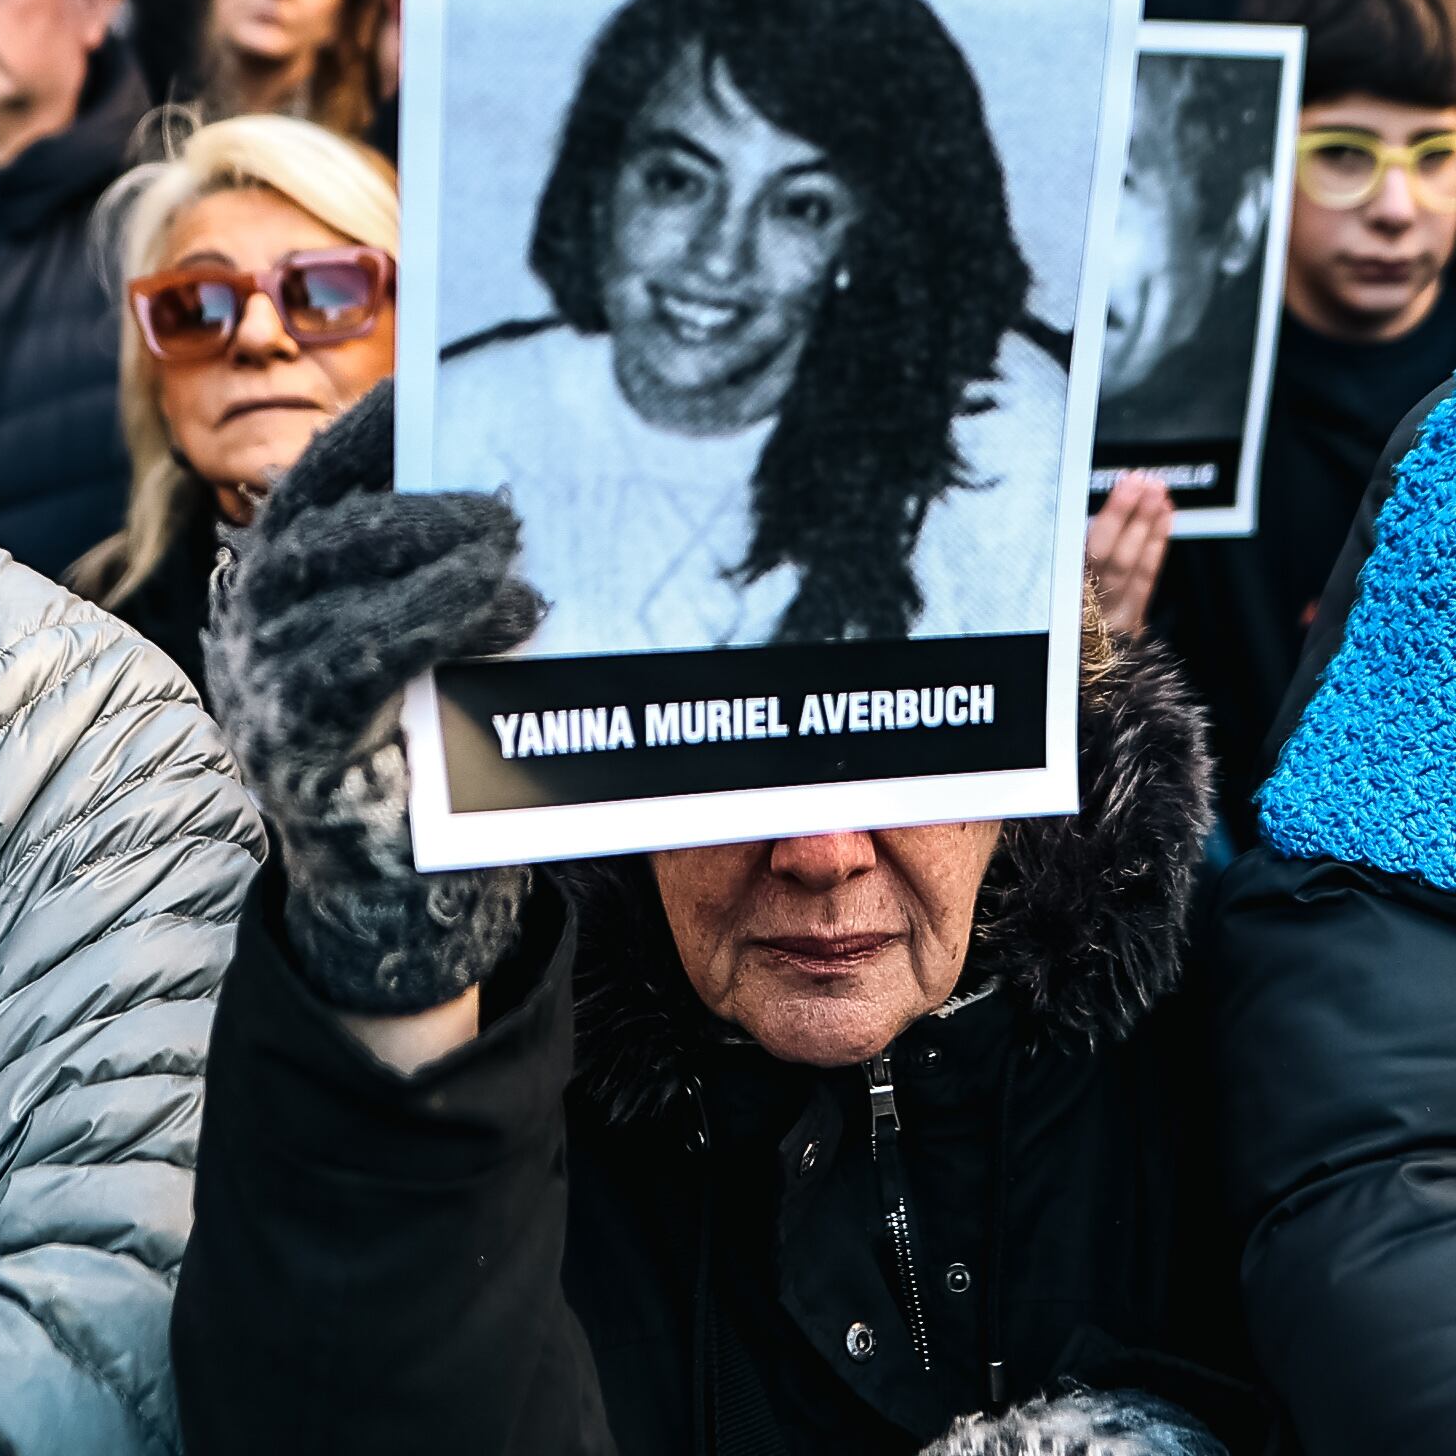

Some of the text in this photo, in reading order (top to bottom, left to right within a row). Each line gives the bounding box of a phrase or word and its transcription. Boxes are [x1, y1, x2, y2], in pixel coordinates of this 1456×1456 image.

[491, 684, 995, 759] YANINA MURIEL AVERBUCH
